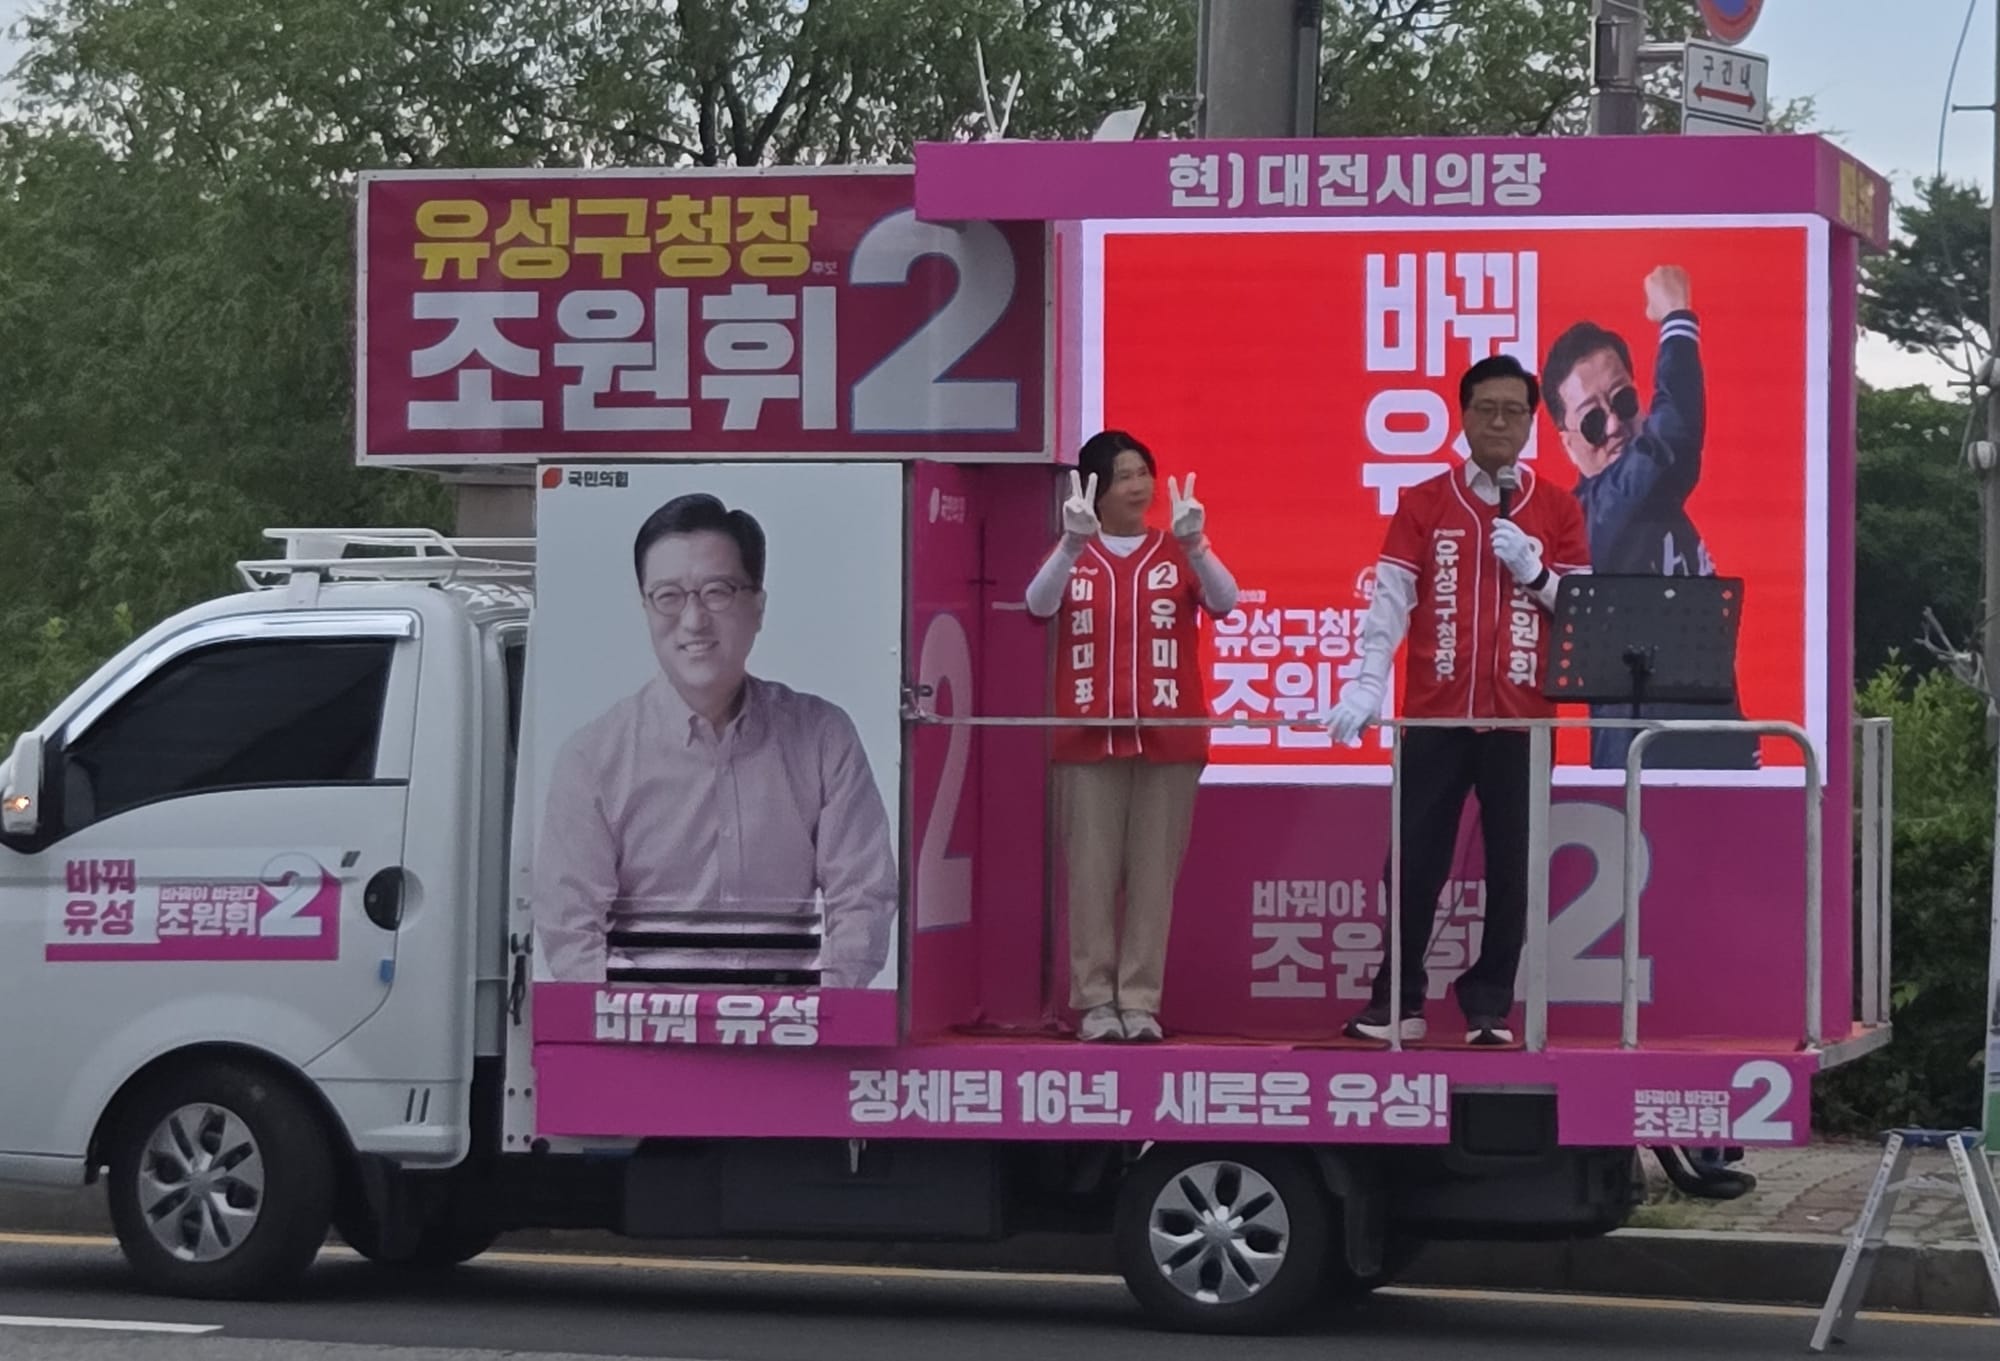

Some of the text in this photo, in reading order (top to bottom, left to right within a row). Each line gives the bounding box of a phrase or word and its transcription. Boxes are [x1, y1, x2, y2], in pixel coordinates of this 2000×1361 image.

[413, 195, 818, 280] 유성구청장
[849, 207, 1020, 434] 2
[1366, 251, 1538, 377] 바꿔
[407, 283, 838, 432] 조원휘
[568, 471, 628, 488] 국민의힘
[1363, 389, 1538, 516] 유
[1154, 562, 1175, 587] 2
[1433, 539, 1459, 676] 유성구청장
[1070, 578, 1096, 705] 비례대표
[1150, 598, 1180, 710] 유미자
[916, 611, 974, 933] 2
[64, 900, 135, 936] 유성
[65, 859, 136, 894] 바꿔
[158, 902, 257, 936] 조원휘
[259, 852, 323, 937] 2
[1252, 879, 1367, 918] 바꿔야
[1514, 800, 1655, 1004] 2
[595, 990, 820, 1046] 바꿔 유성
[849, 1069, 1448, 1127] 정체된 16년, 새로운 유성!
[1633, 1105, 1730, 1139] 조원휘
[1731, 1060, 1793, 1141] 2
